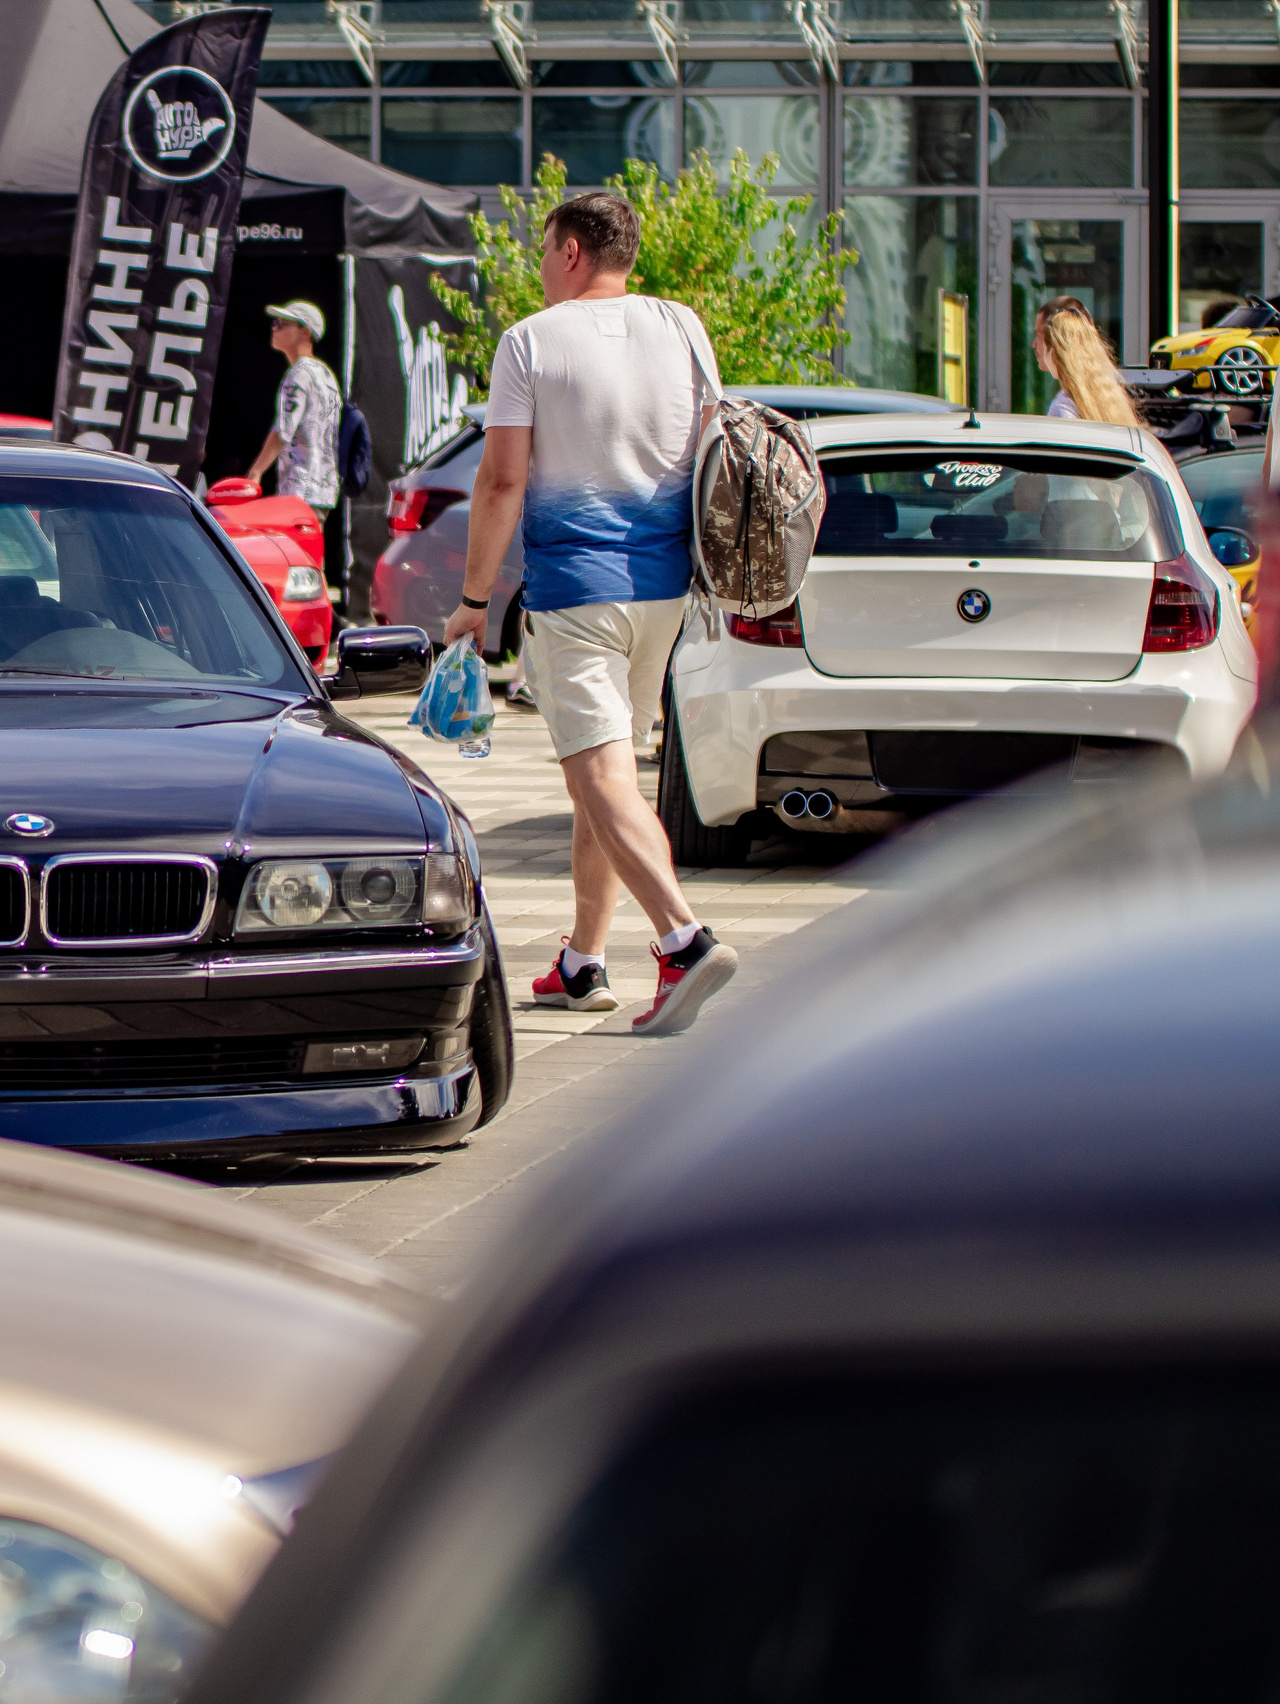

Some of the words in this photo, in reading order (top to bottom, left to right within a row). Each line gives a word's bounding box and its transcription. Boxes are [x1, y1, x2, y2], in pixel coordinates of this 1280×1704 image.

[156, 101, 194, 130] AUTO
[156, 126, 204, 151] HYPE
[236, 223, 303, 242] pe96.ru
[953, 472, 1001, 487] Club
